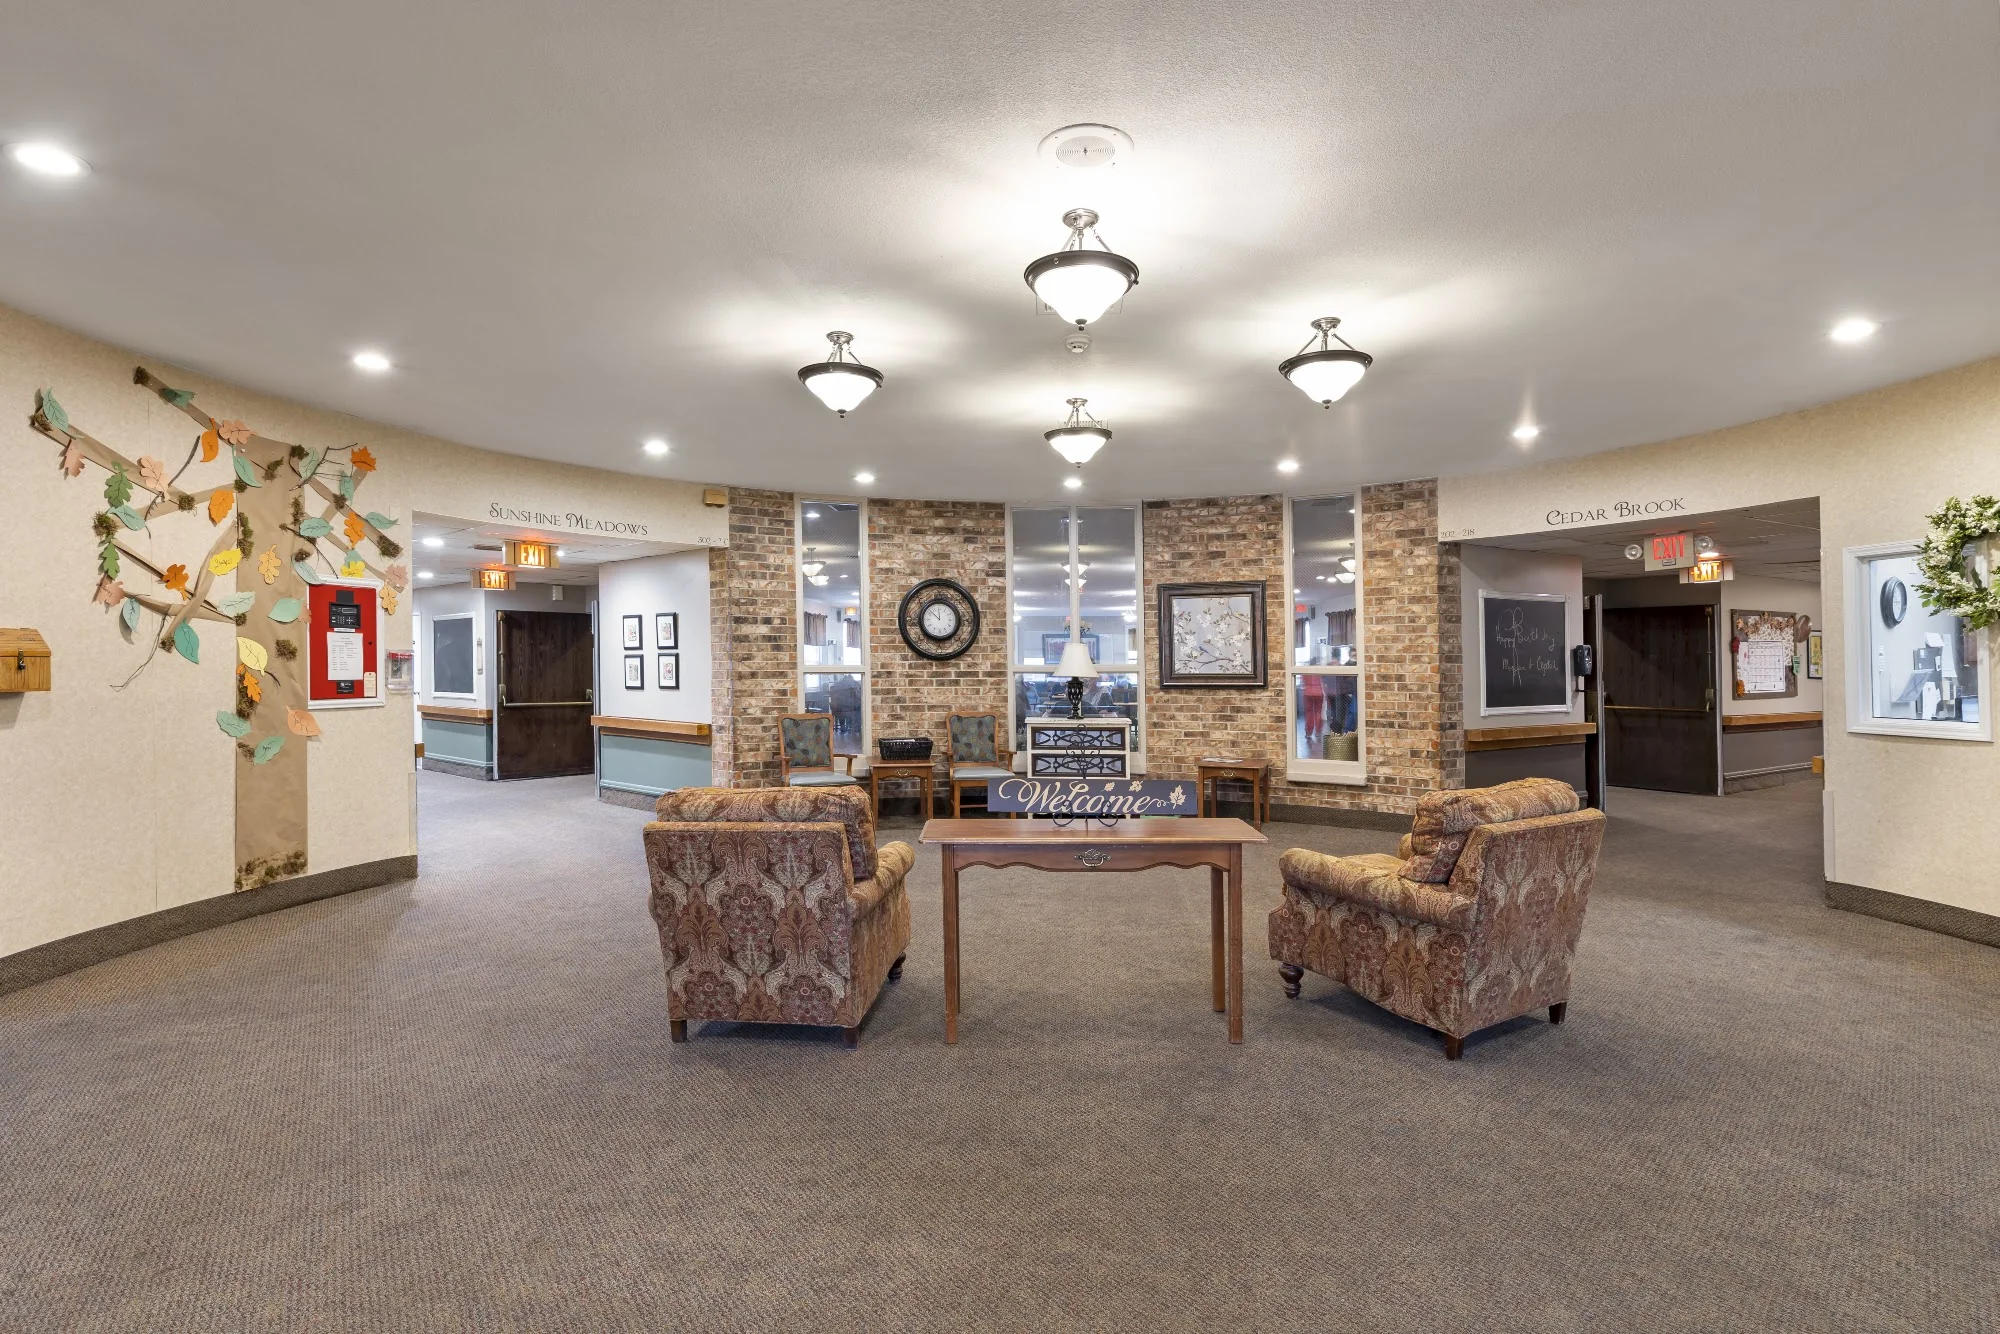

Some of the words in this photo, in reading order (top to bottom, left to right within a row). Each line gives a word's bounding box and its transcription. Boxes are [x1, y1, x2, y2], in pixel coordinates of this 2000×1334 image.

[489, 503, 562, 527] SUNSHINE
[565, 512, 648, 536] MEADOWS
[1546, 509, 1608, 526] CEDAR
[1614, 498, 1687, 518] BROOK
[1462, 528, 1475, 537] 218
[520, 544, 547, 566] EXIT
[1652, 535, 1687, 560] EXIT
[484, 571, 507, 589] EXIT
[1693, 562, 1720, 582] EXIT
[998, 778, 1166, 814] Welcome
